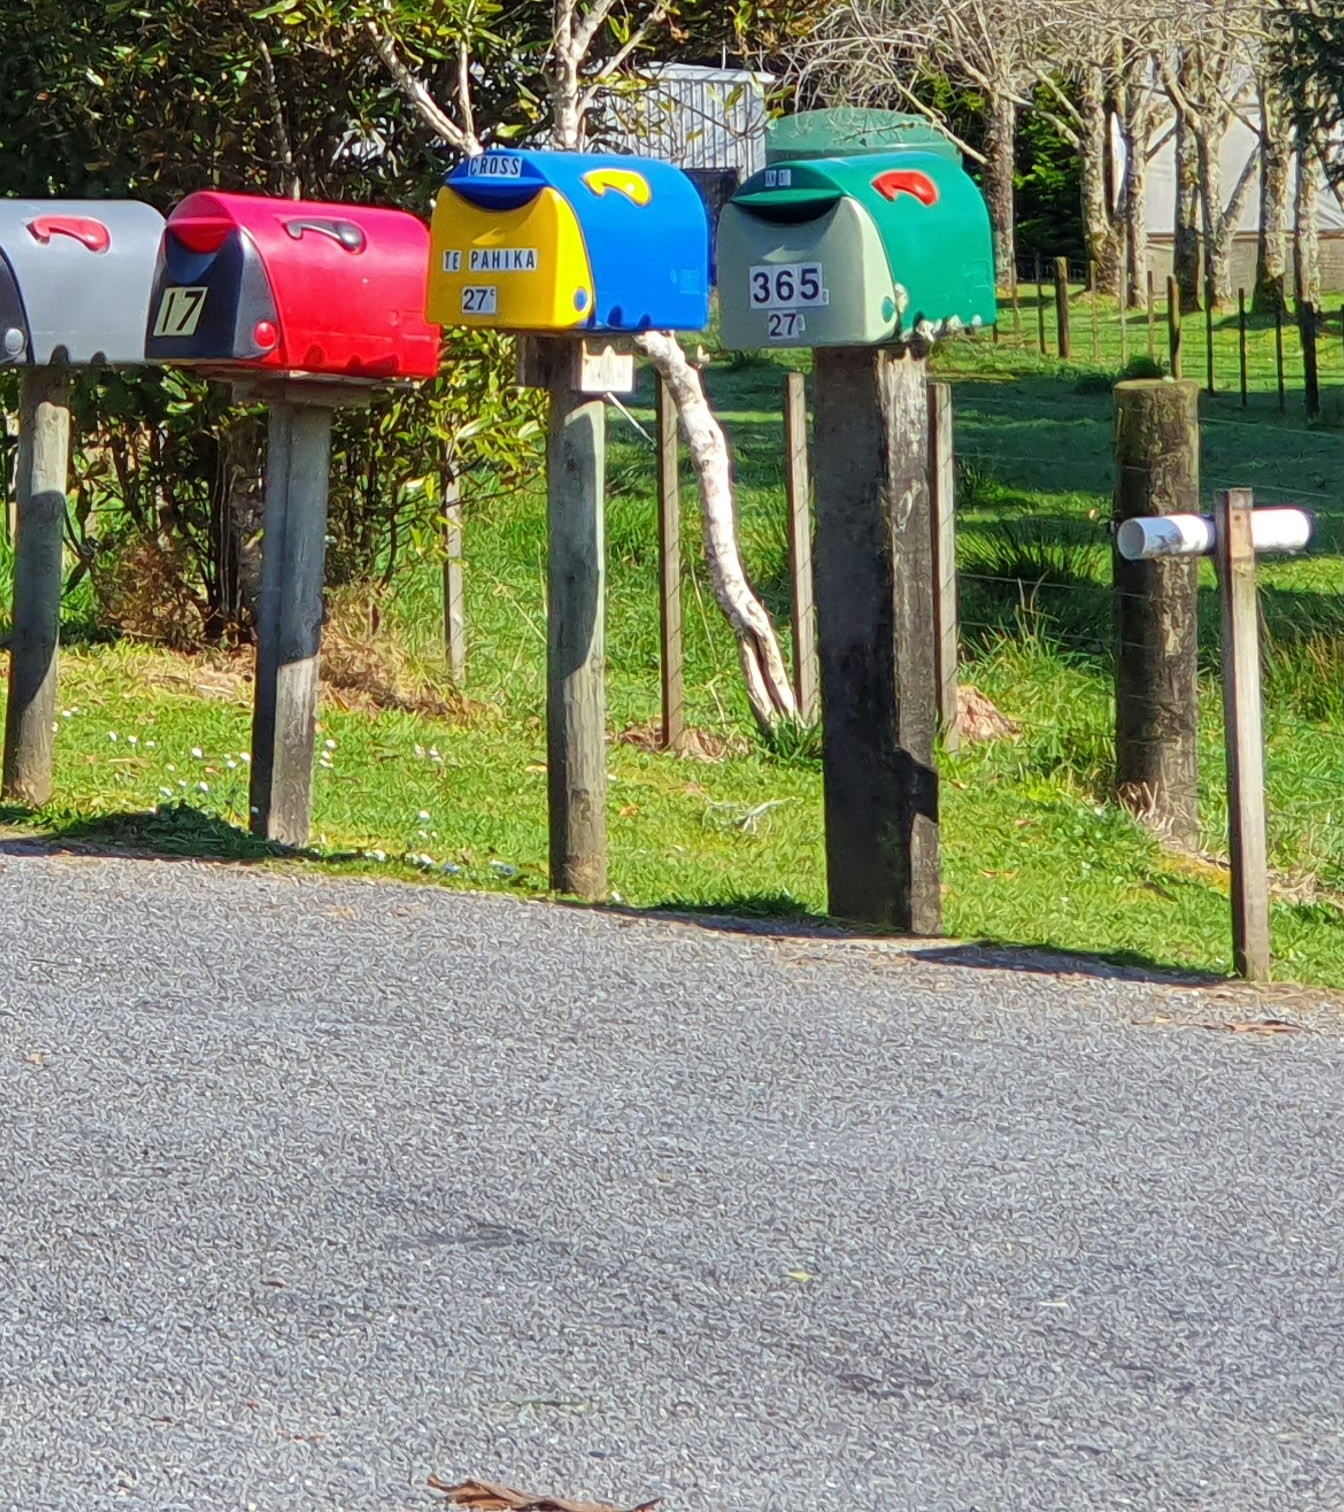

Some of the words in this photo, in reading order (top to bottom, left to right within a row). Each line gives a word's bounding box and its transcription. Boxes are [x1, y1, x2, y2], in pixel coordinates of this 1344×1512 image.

[470, 157, 520, 176] CROSS
[445, 252, 459, 270] TE
[471, 250, 535, 270] PAHIKA
[753, 268, 819, 303] 365
[161, 290, 204, 333] 17
